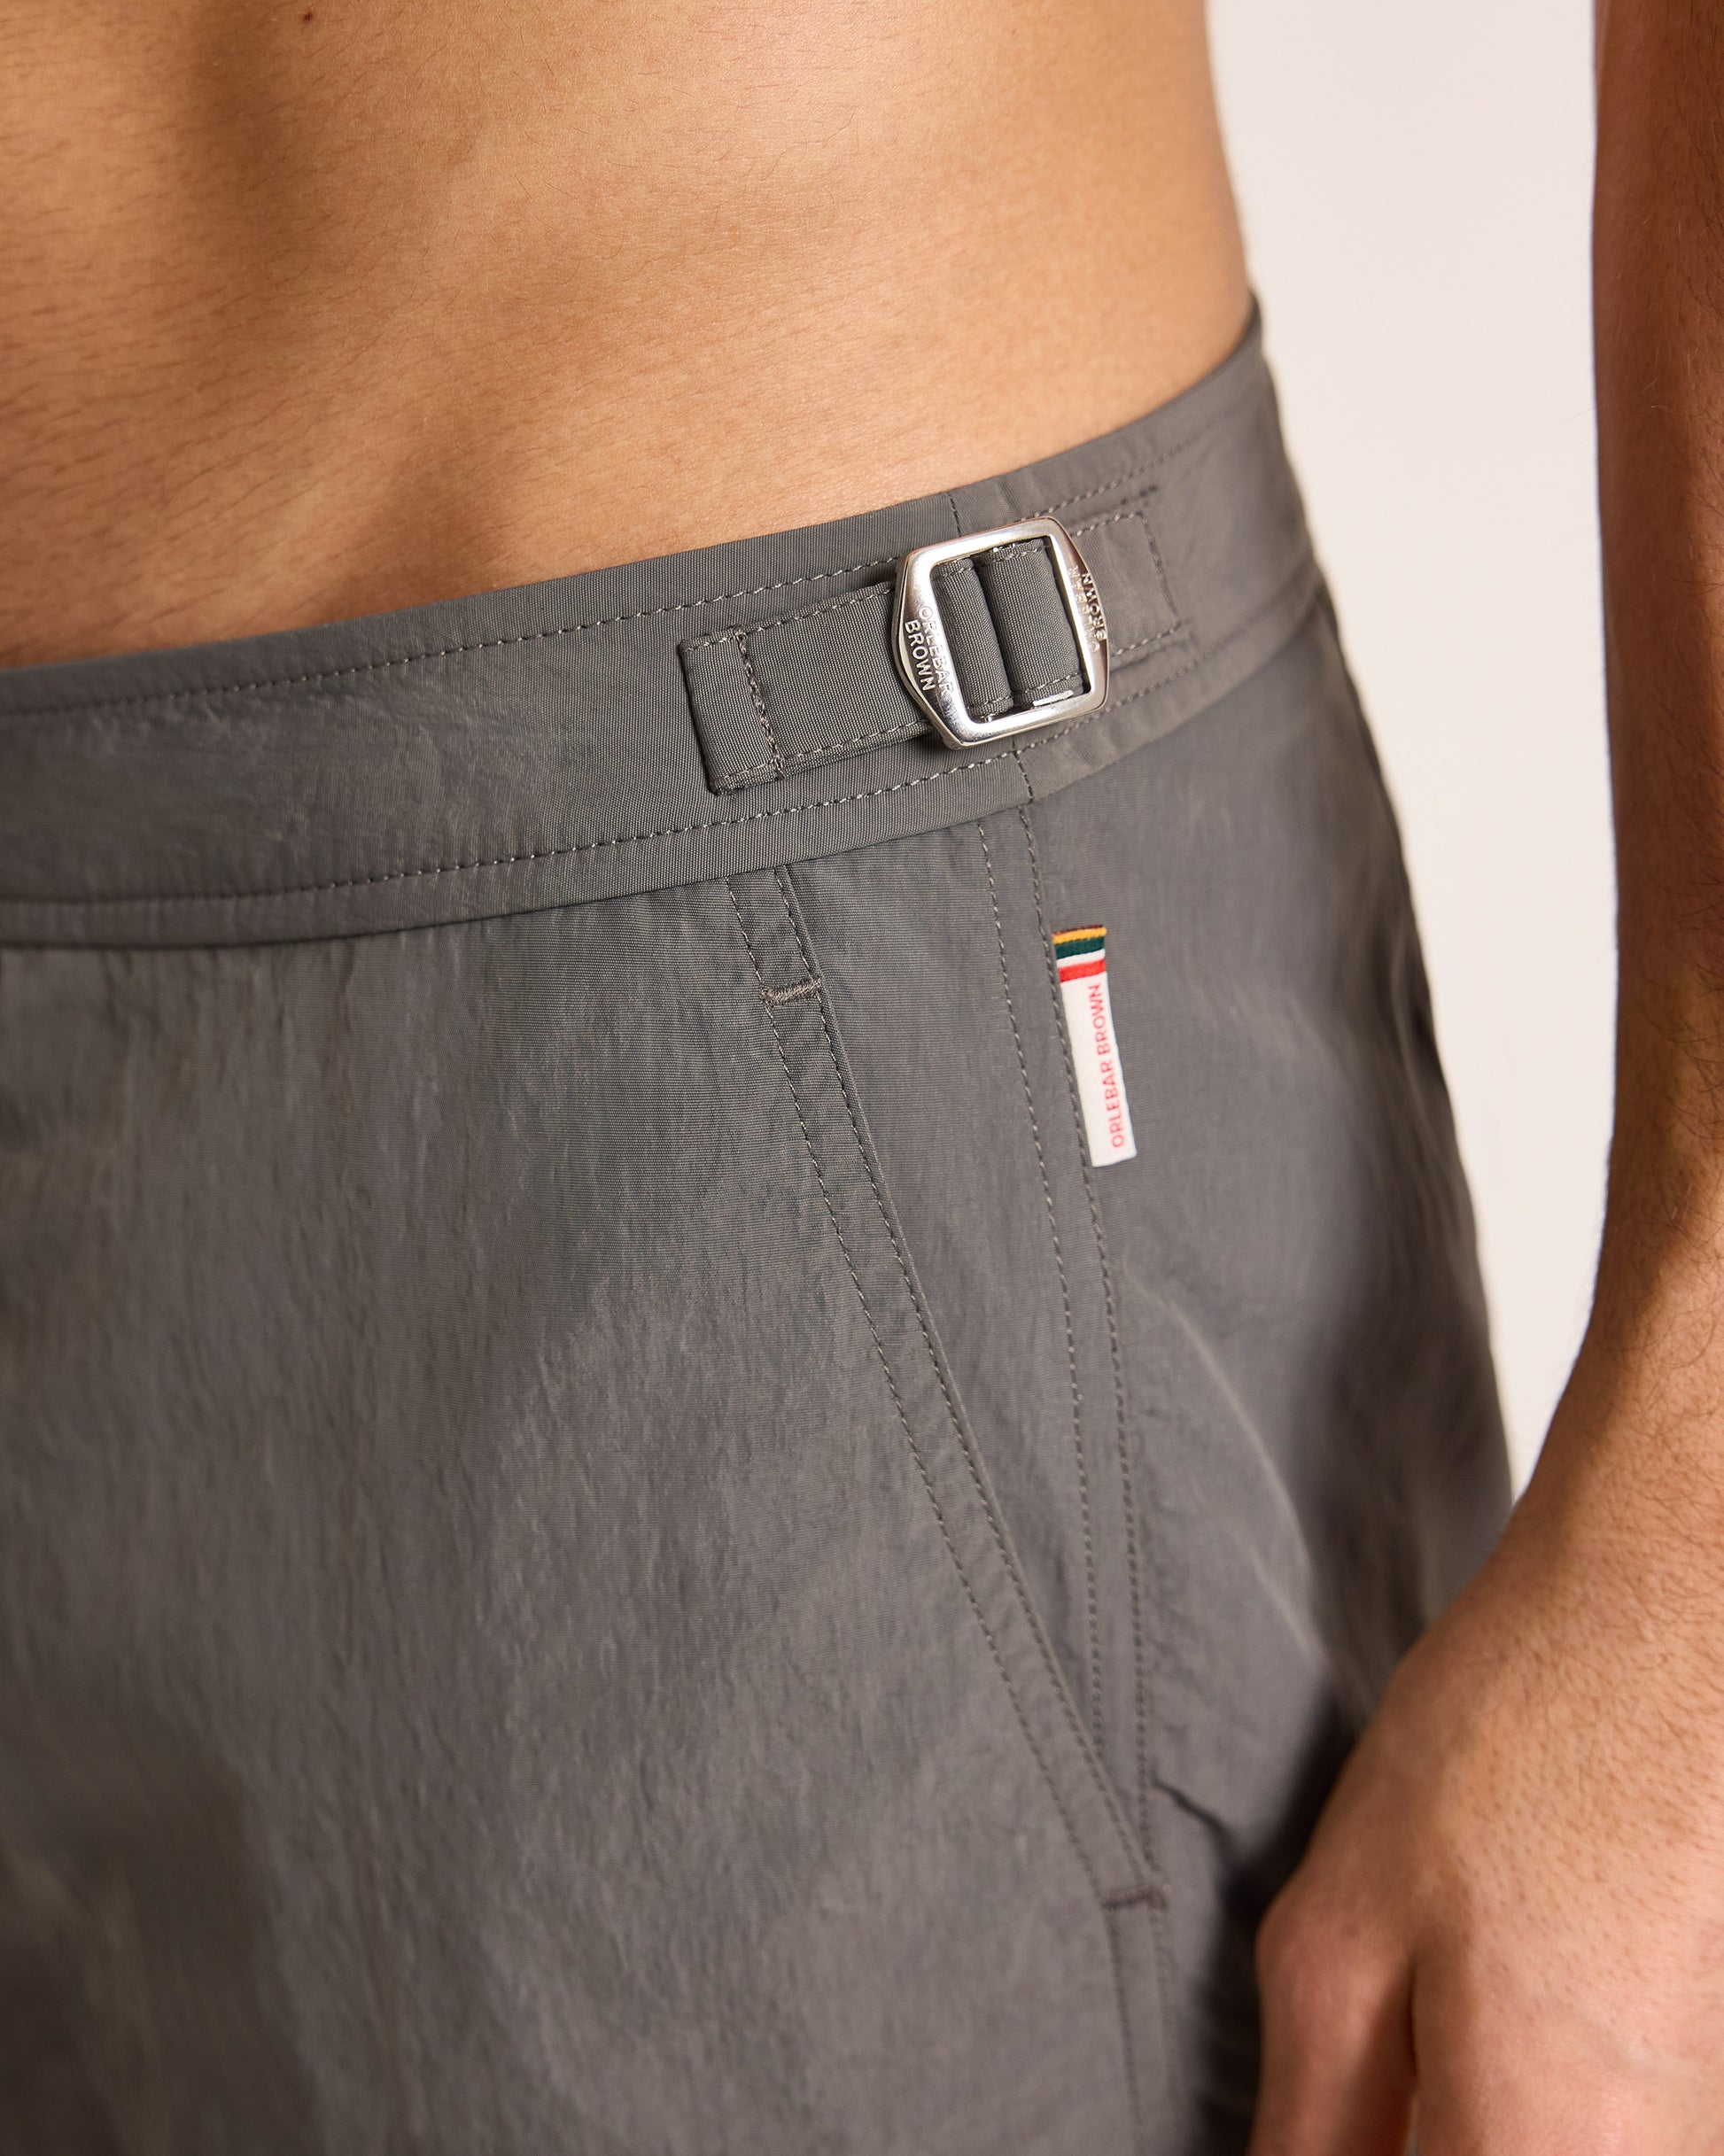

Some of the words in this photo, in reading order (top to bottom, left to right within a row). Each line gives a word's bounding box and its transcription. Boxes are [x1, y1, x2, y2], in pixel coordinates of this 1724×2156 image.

[1082, 573, 1107, 641] BROWN
[905, 619, 936, 691] BROWN
[919, 606, 953, 695] ORLEBAR
[1088, 983, 1111, 1056] BROWN
[1099, 1059, 1125, 1149] ORLEBAR
